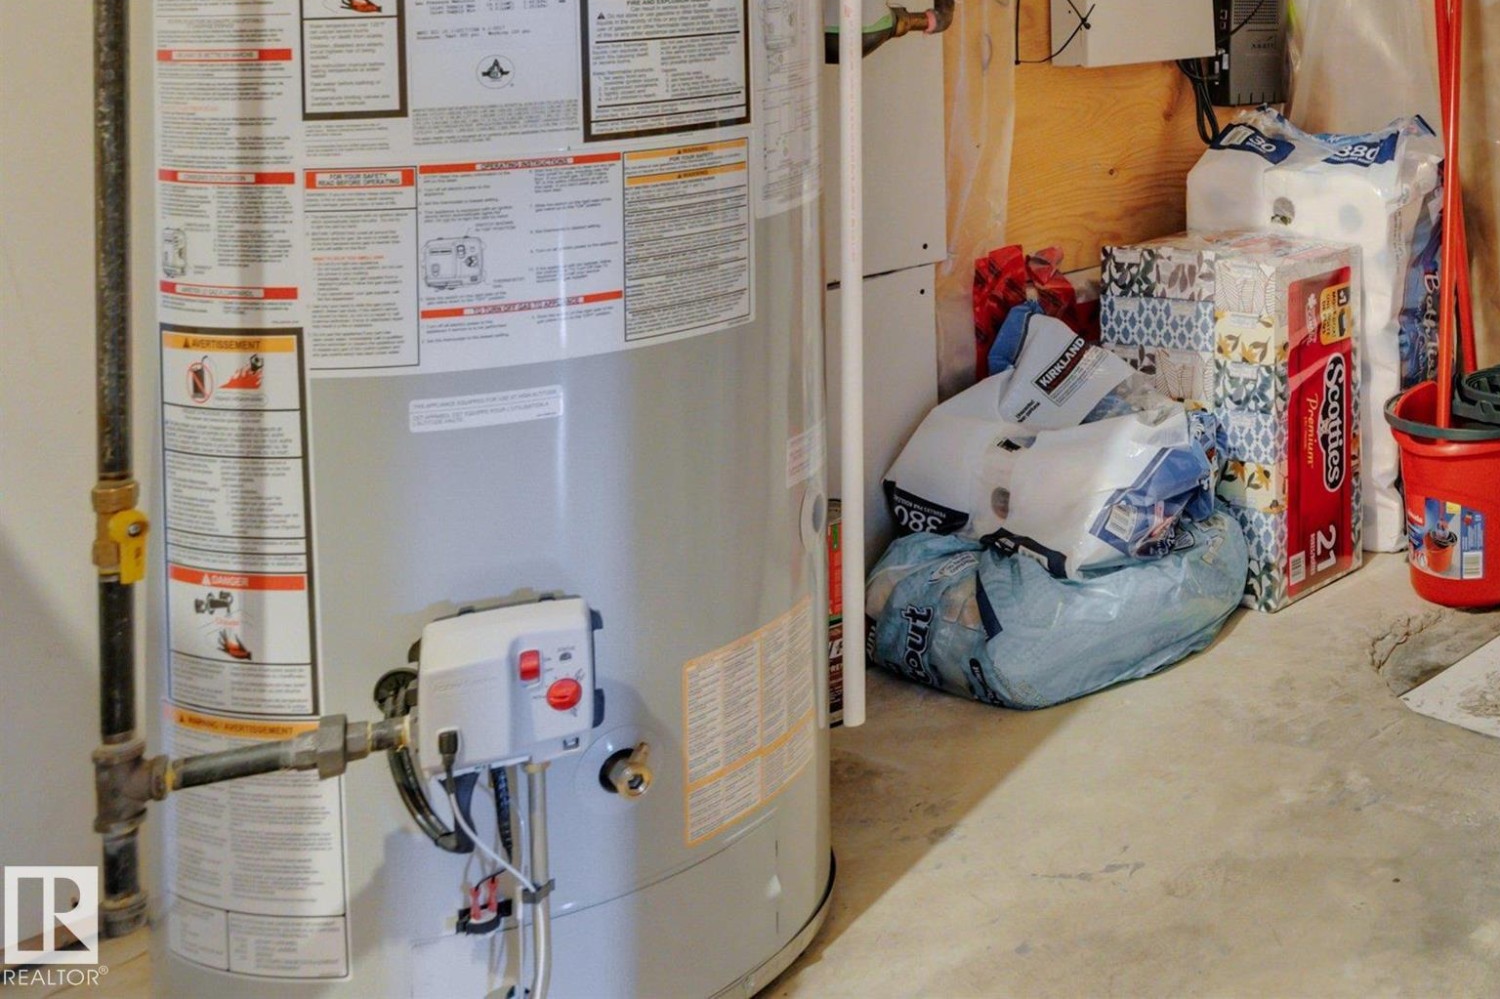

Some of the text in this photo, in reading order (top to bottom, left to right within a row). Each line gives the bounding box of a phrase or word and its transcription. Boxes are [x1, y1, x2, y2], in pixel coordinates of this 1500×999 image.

[317, 177, 401, 187] READ BEFORE OPERATING
[362, 172, 388, 180] SAFETY
[191, 338, 263, 351] AVERTISSEMENT
[1039, 337, 1086, 388] KIRKLAND
[1305, 393, 1319, 466] Premium
[1325, 361, 1346, 485] Scotties
[1316, 524, 1337, 572] 21
[210, 574, 249, 588] DANGER
